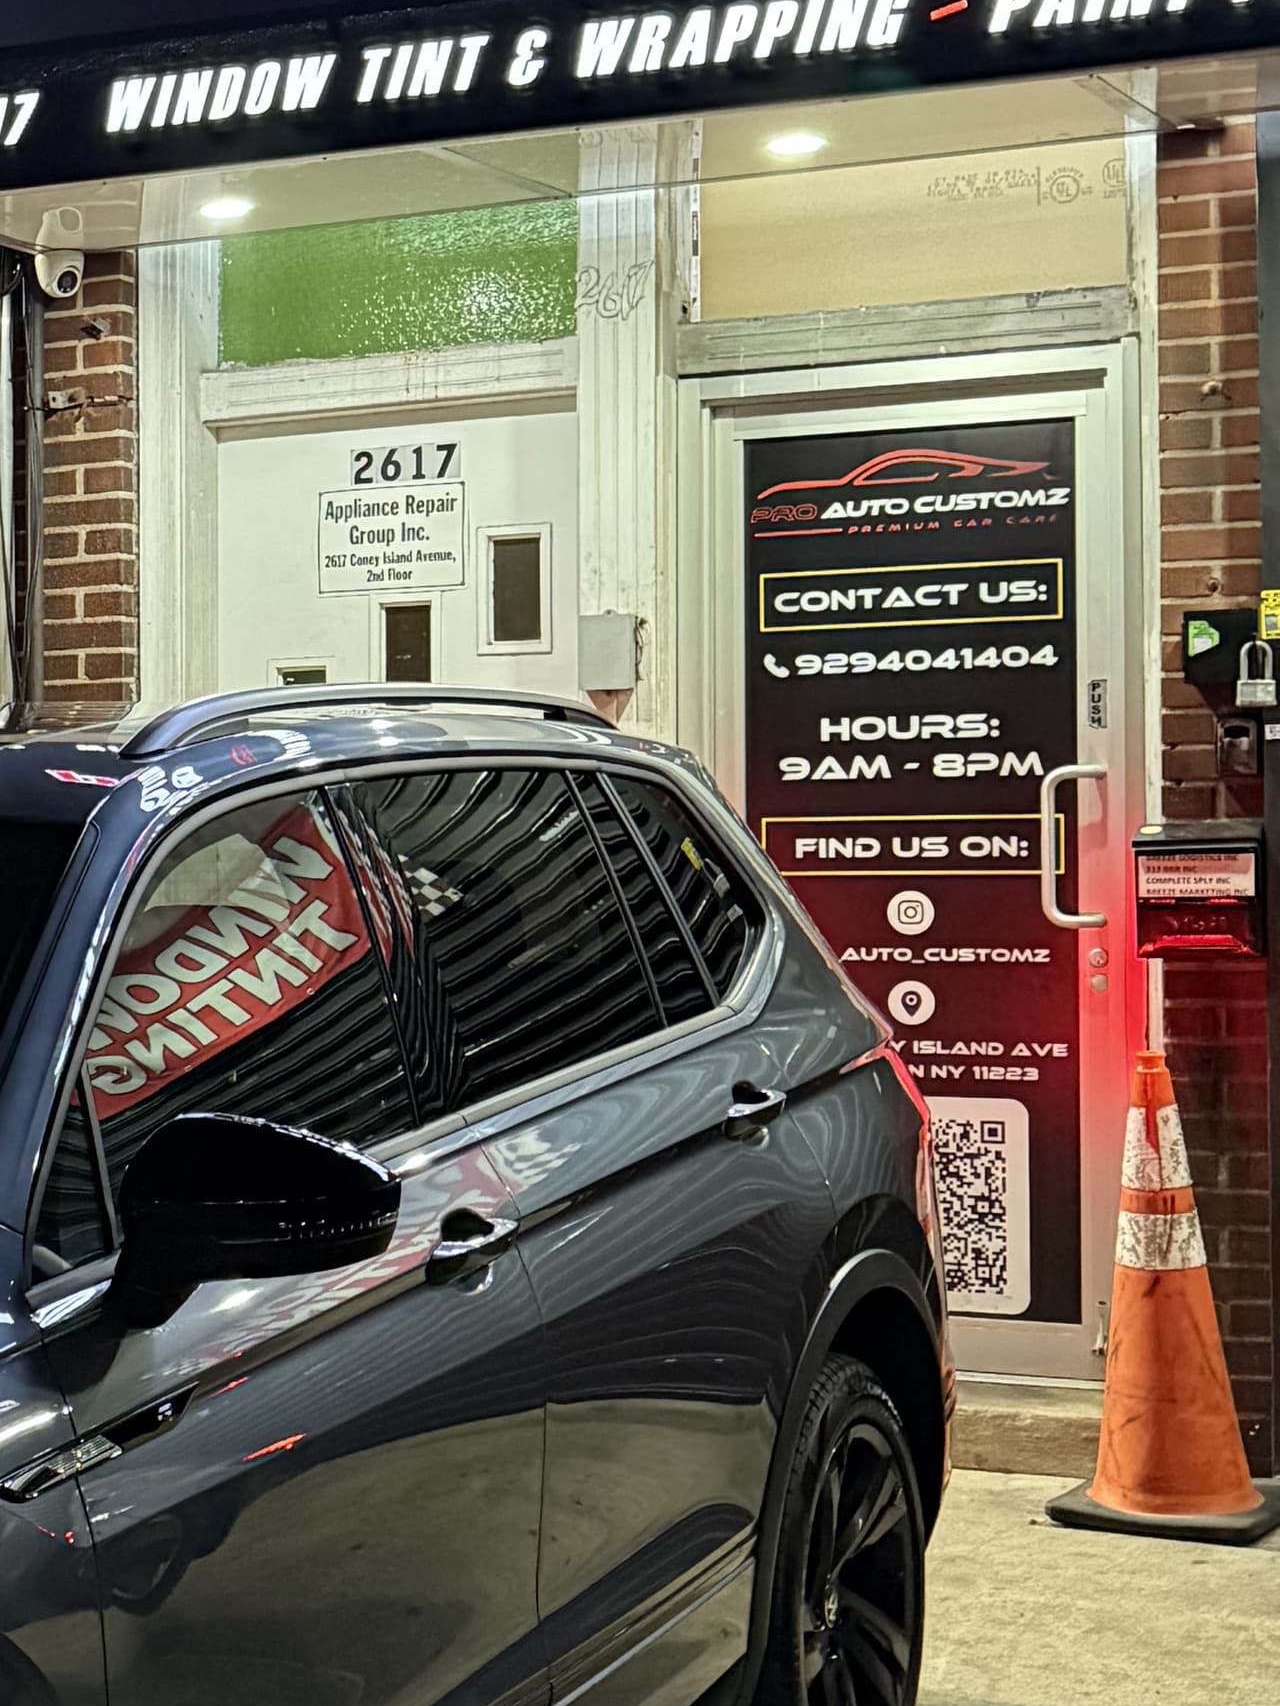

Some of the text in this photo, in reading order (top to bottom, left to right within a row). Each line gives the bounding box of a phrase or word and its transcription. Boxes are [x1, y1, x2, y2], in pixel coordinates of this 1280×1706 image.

[106, 53, 336, 134] WINDOW
[356, 33, 490, 104] TINT
[508, 28, 548, 86] &
[354, 443, 458, 485] 2617
[325, 493, 458, 523] Appliance Repair
[751, 487, 1071, 524] PRO AUTO CUSTOMZ
[350, 522, 430, 546] Group Inc.
[848, 514, 1057, 534] PREMIUM CAR CARE
[325, 549, 456, 568] 2617 Coney Island Avenue,
[367, 568, 413, 582] 2nd Floor
[774, 579, 1048, 613] CONTACT US:
[794, 645, 1059, 675] 9294041404
[820, 713, 1000, 742] HOURS:
[778, 755, 891, 781] 9AM
[933, 751, 1044, 777] 8PM
[794, 836, 1029, 859] FIND US ON:
[840, 947, 1051, 964] AUTO_CUSTOMZ
[913, 1040, 1004, 1056] ISLAND
[1010, 1043, 1069, 1058] AVE
[931, 1065, 966, 1079] NY
[972, 1065, 1039, 1081] 11223
